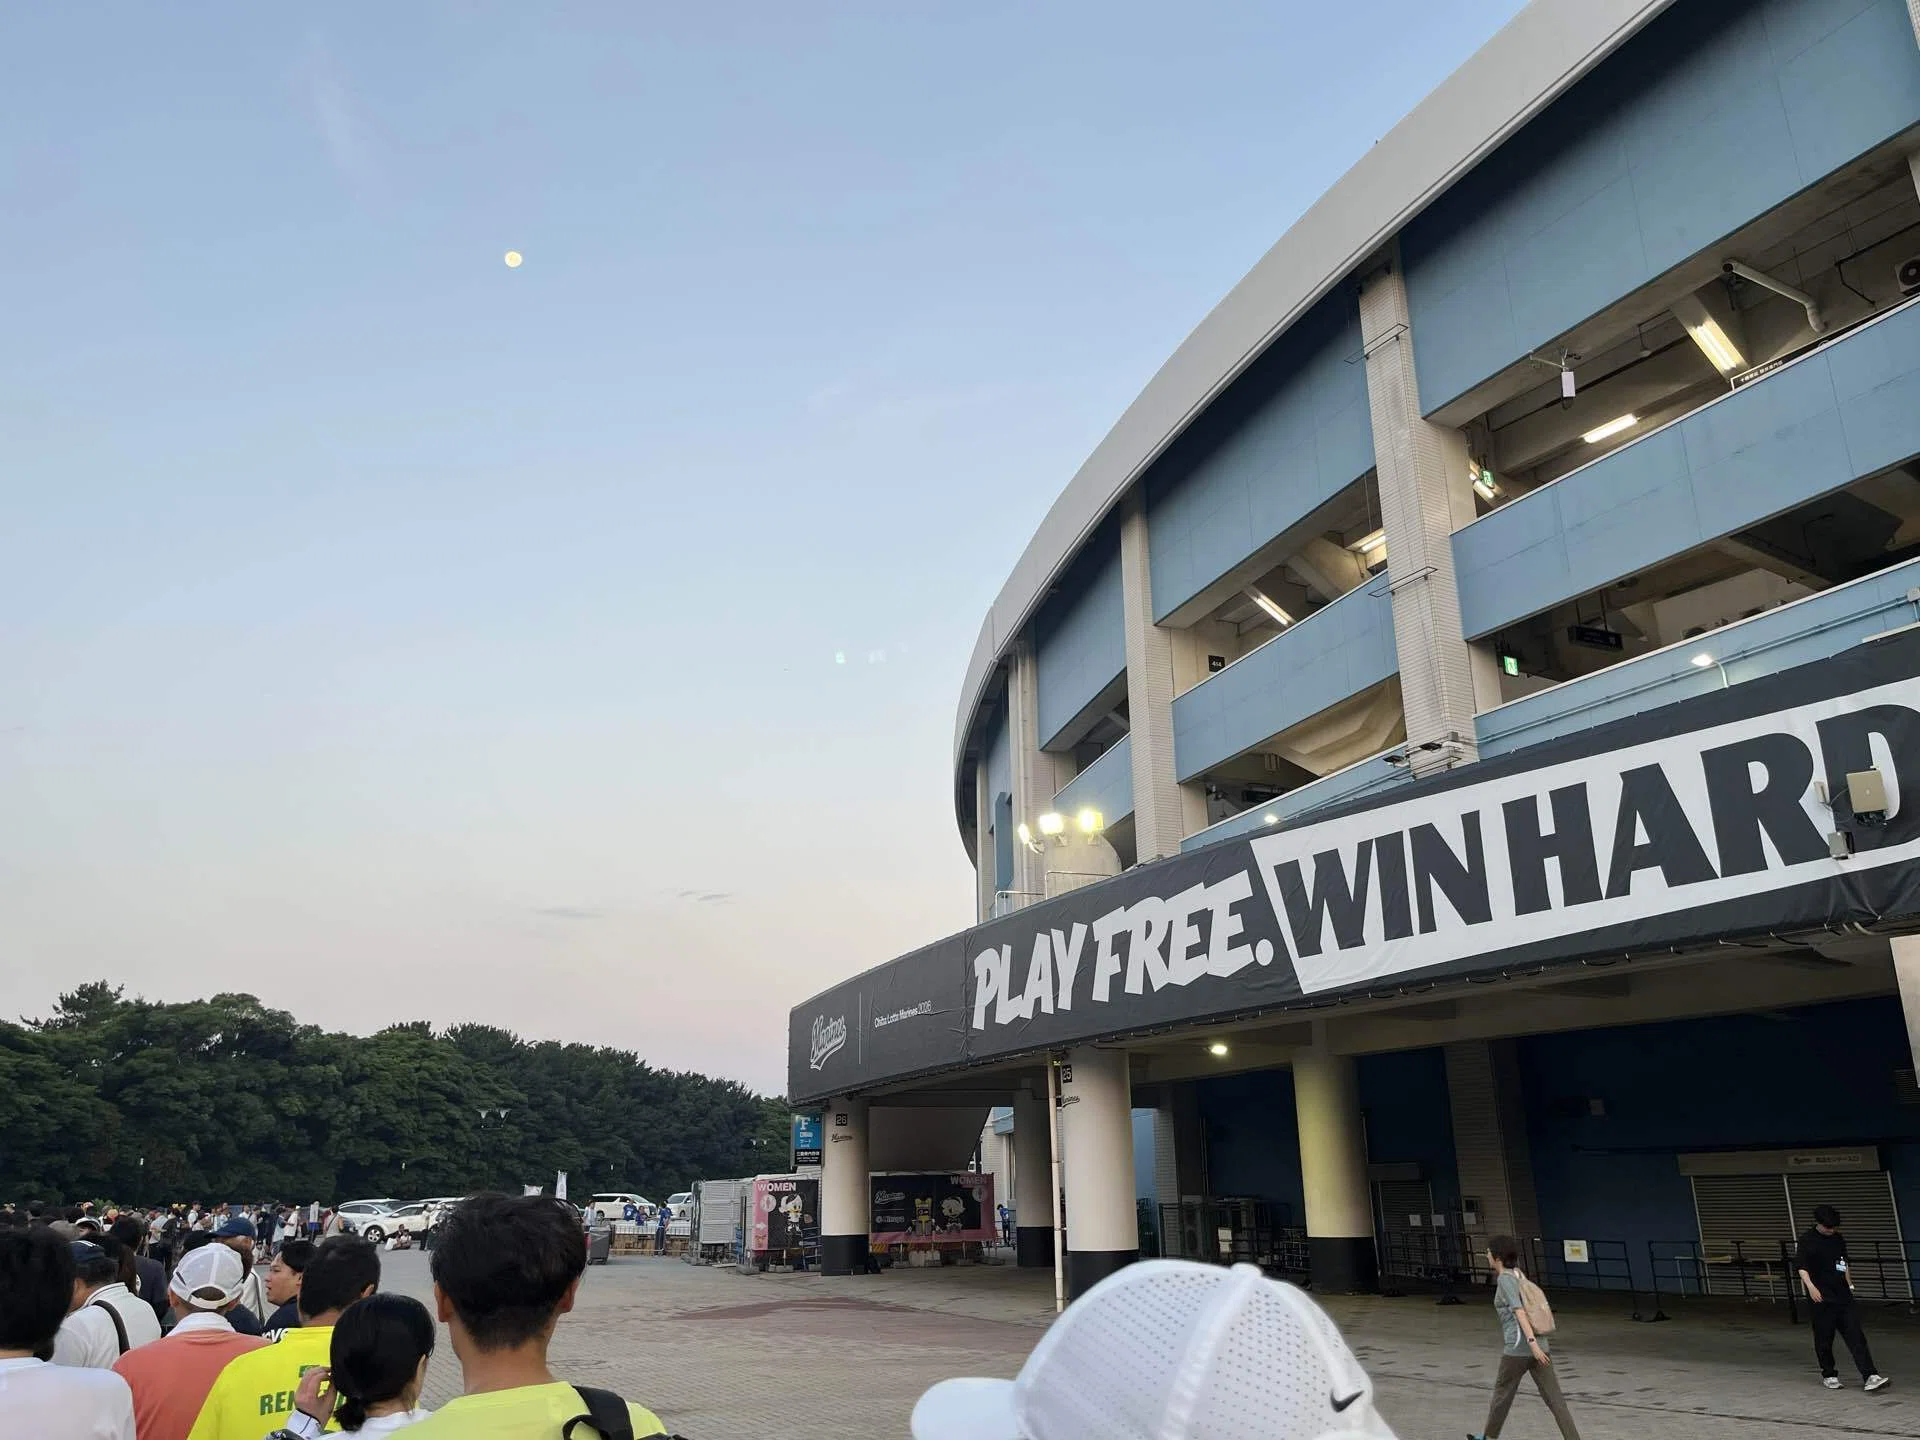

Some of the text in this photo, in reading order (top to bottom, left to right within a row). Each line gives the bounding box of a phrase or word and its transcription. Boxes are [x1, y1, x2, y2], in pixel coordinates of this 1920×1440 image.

[972, 921, 1088, 1030] PLAY
[1092, 869, 1274, 1002] FREE.
[1063, 1067, 1072, 1080] 25
[799, 1115, 811, 1130] F
[950, 1175, 987, 1185] WOMEN
[757, 1182, 797, 1192] WOMEN
